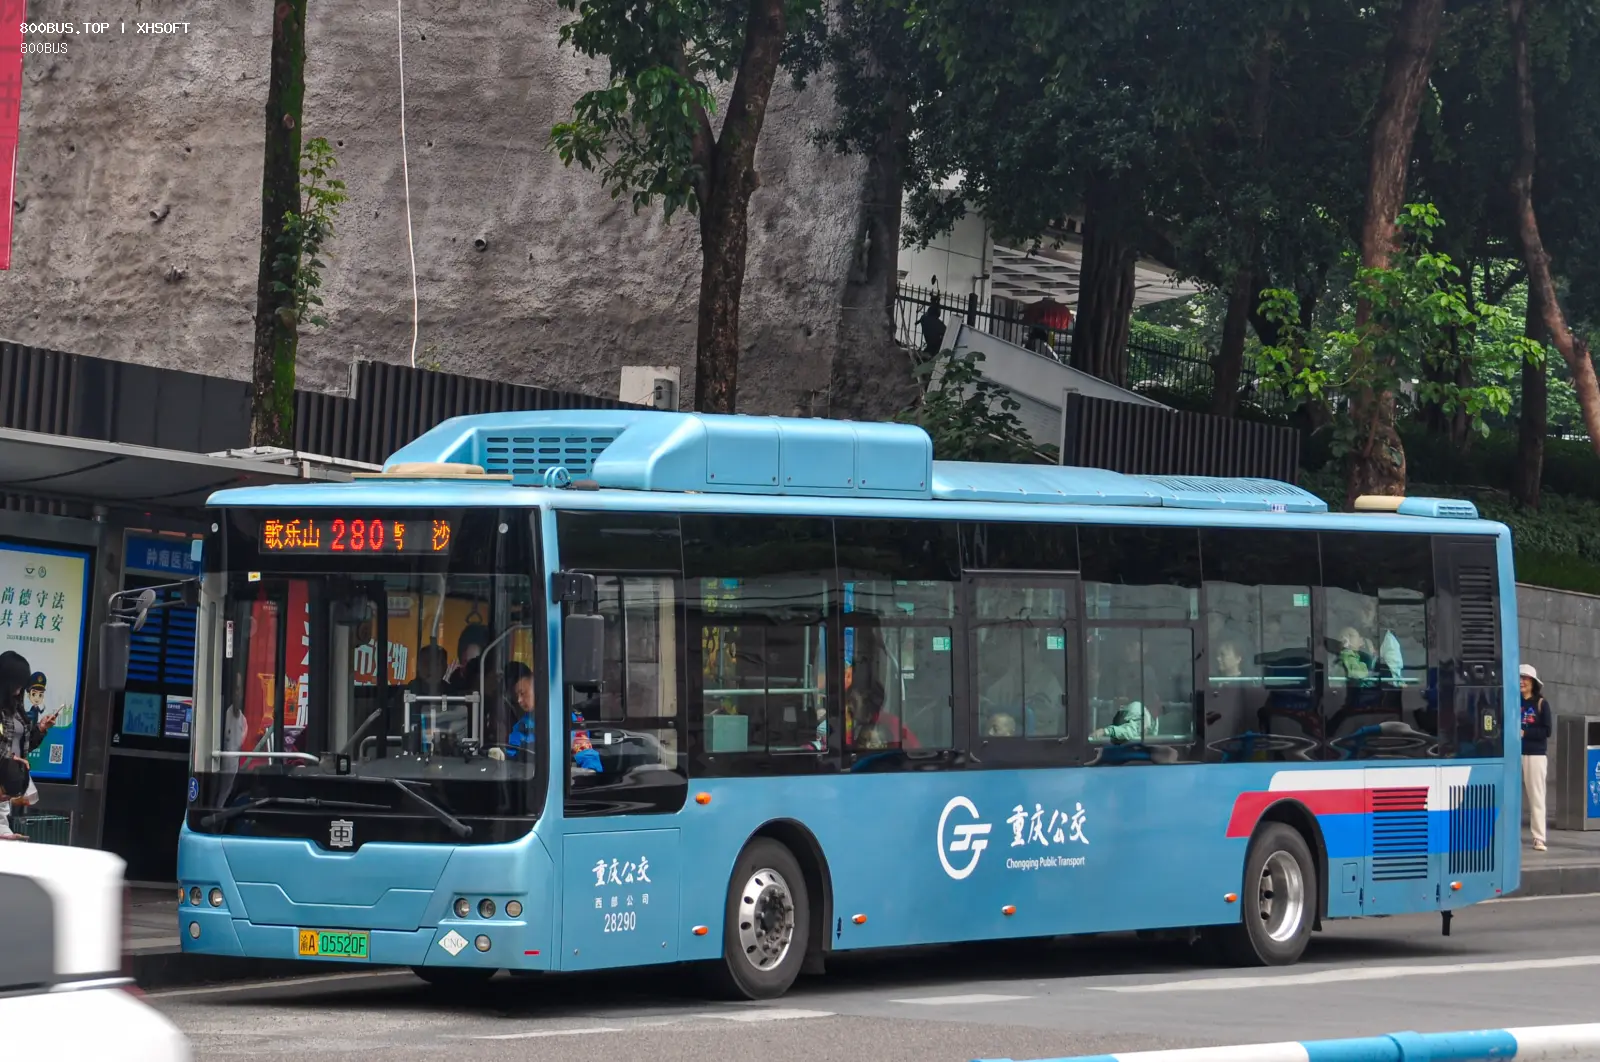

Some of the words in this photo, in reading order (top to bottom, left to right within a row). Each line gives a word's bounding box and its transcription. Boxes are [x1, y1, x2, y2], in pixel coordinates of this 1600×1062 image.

[264, 519, 320, 549] 歌乐山
[331, 519, 385, 551] 280
[1, 586, 65, 610] 尚德守法
[0, 608, 64, 632] 共享食安
[1006, 802, 1090, 848] 重庆公交
[592, 855, 652, 887] 重庆公交
[1006, 857, 1039, 871] Chongqing
[1040, 856, 1057, 867] Public
[1058, 855, 1085, 868] Transport
[595, 893, 649, 909] 西部公司
[604, 911, 636, 933] 28290
[443, 937, 463, 948] CNG
